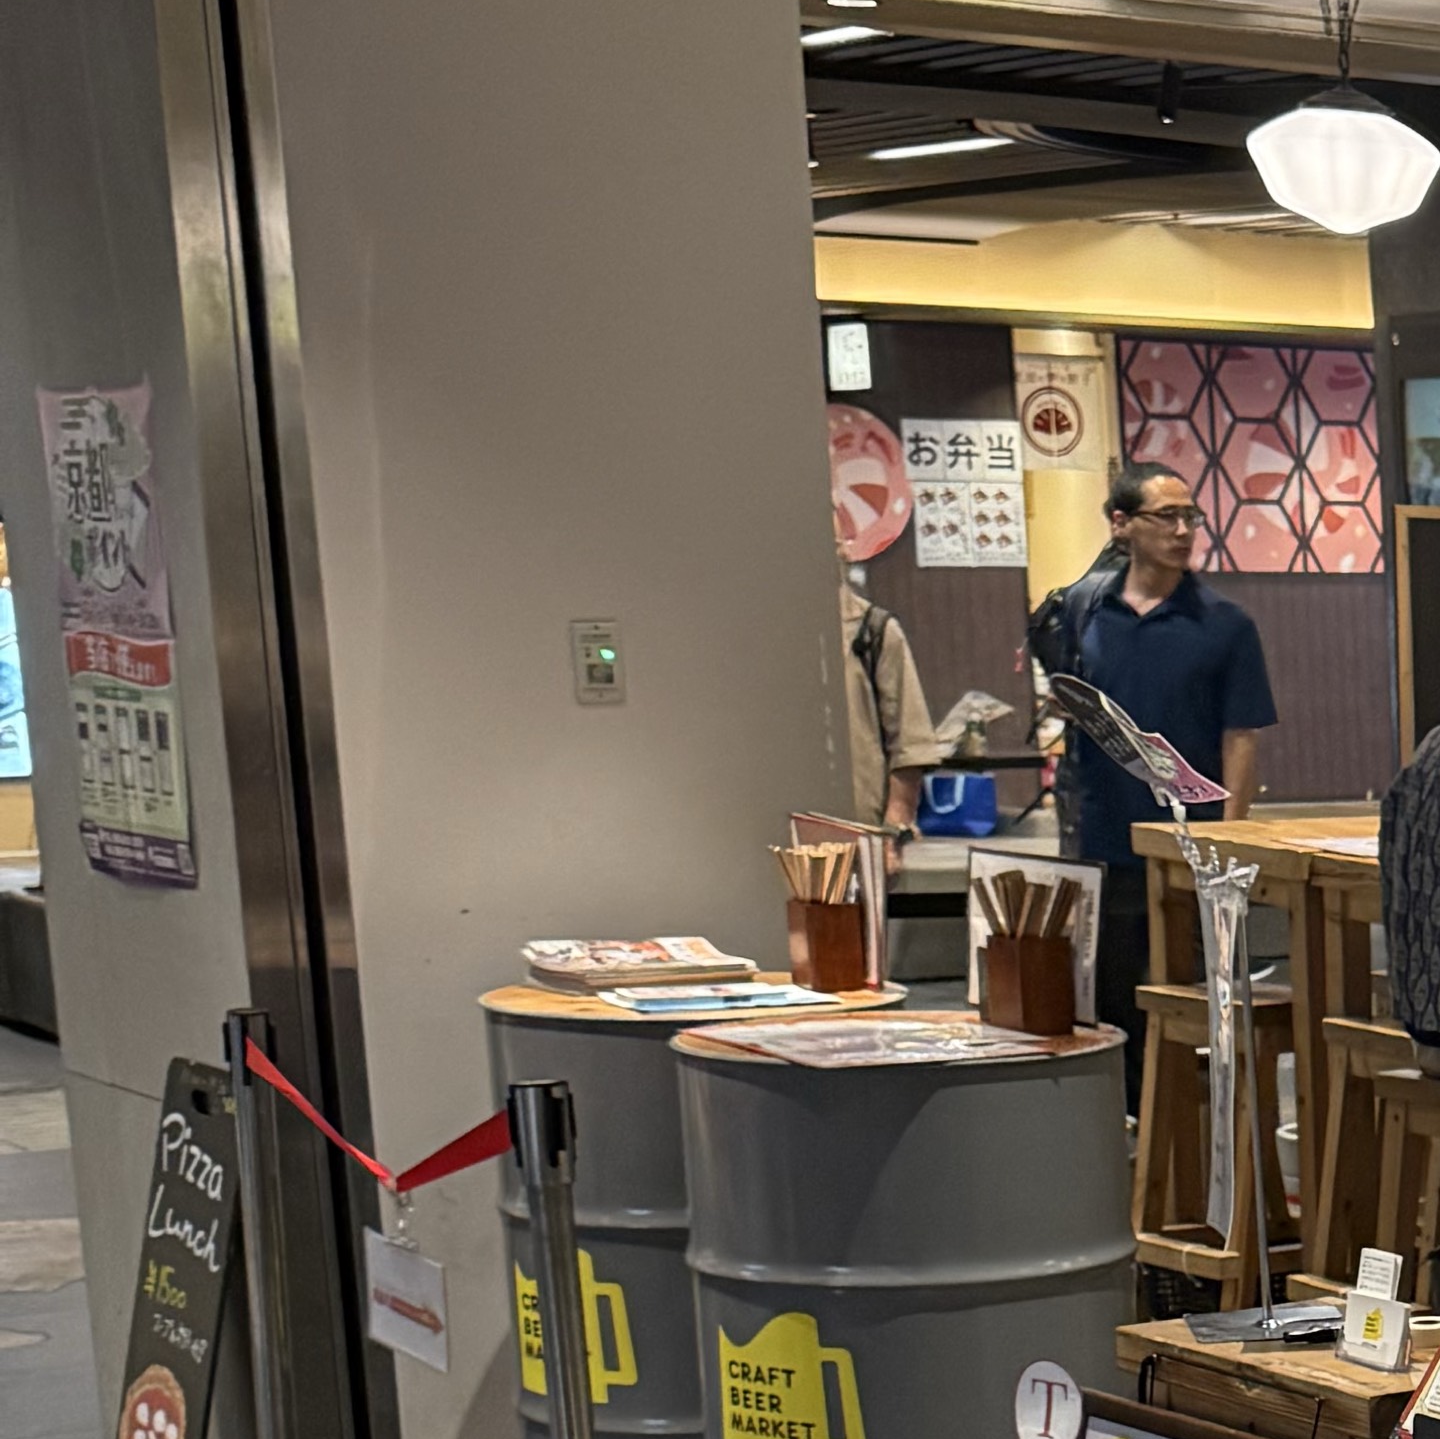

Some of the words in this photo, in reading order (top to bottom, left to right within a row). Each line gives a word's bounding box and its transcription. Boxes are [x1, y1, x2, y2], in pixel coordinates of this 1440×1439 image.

[907, 432, 1015, 471] お弁当
[162, 1112, 224, 1201] Pizza
[149, 1184, 220, 1272] Lunch
[728, 1360, 795, 1388] CRAFT
[730, 1387, 781, 1413] BEER
